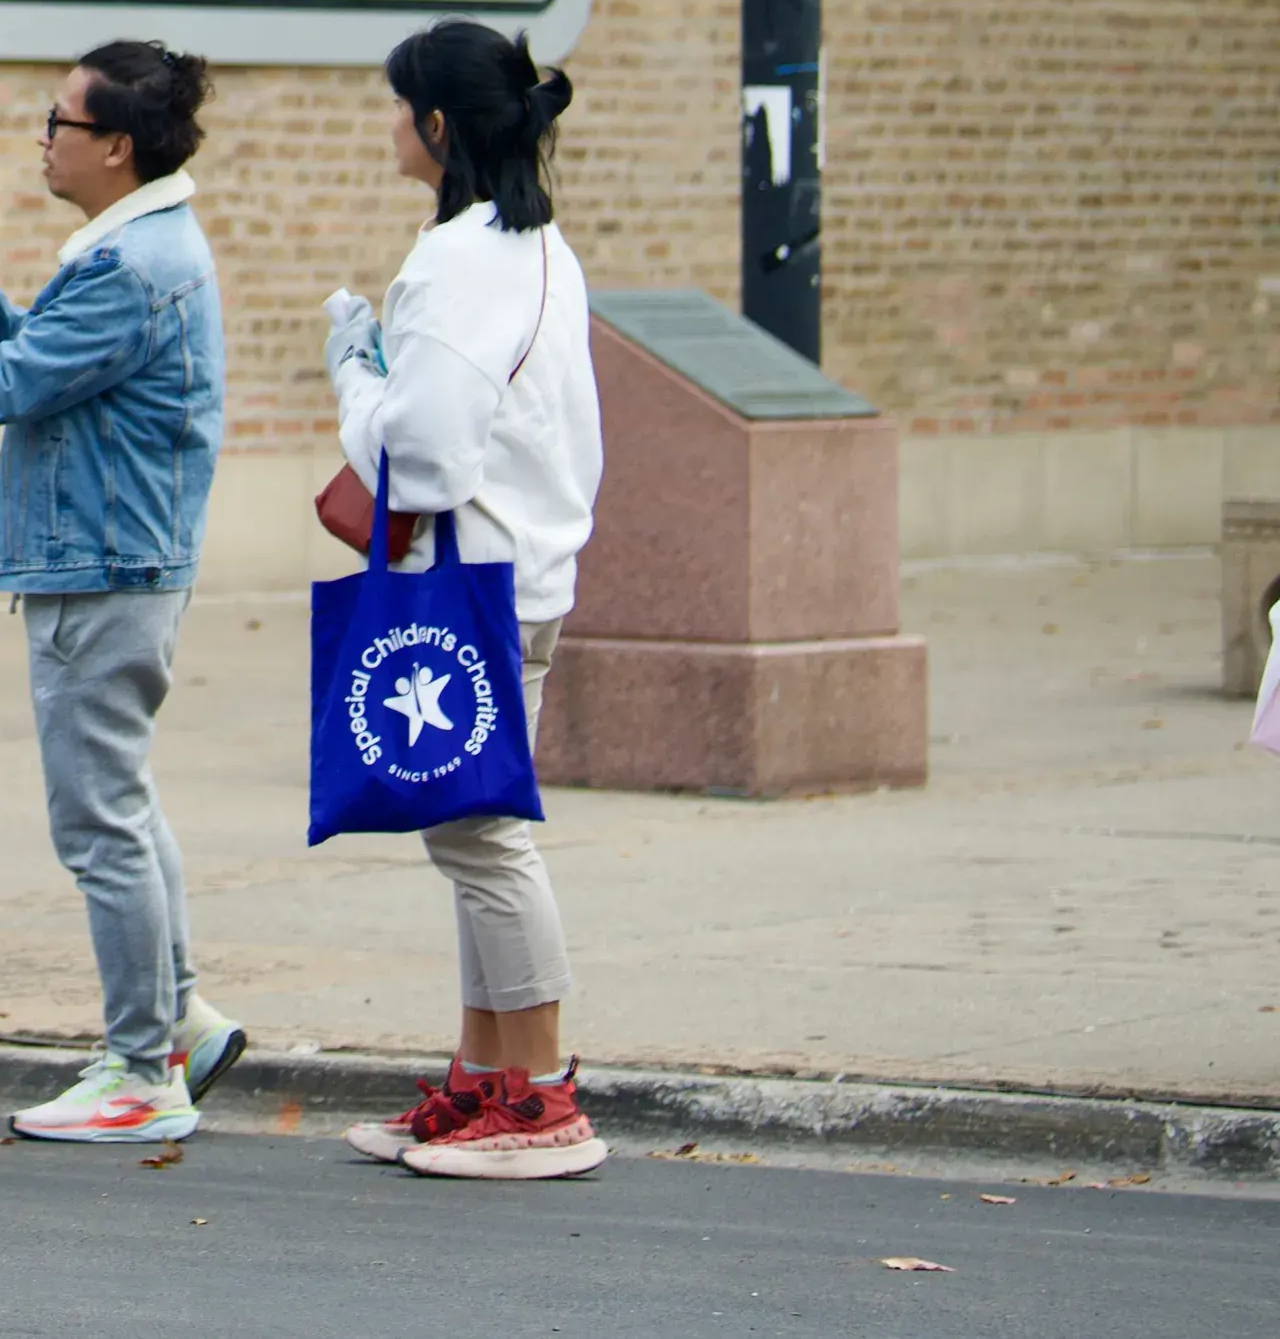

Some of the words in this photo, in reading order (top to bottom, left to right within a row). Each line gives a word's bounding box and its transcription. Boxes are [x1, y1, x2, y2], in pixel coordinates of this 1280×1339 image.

[345, 669, 383, 765] Special
[456, 644, 499, 756] Charities
[388, 763, 429, 782] SINCE
[434, 757, 462, 779] 1969
